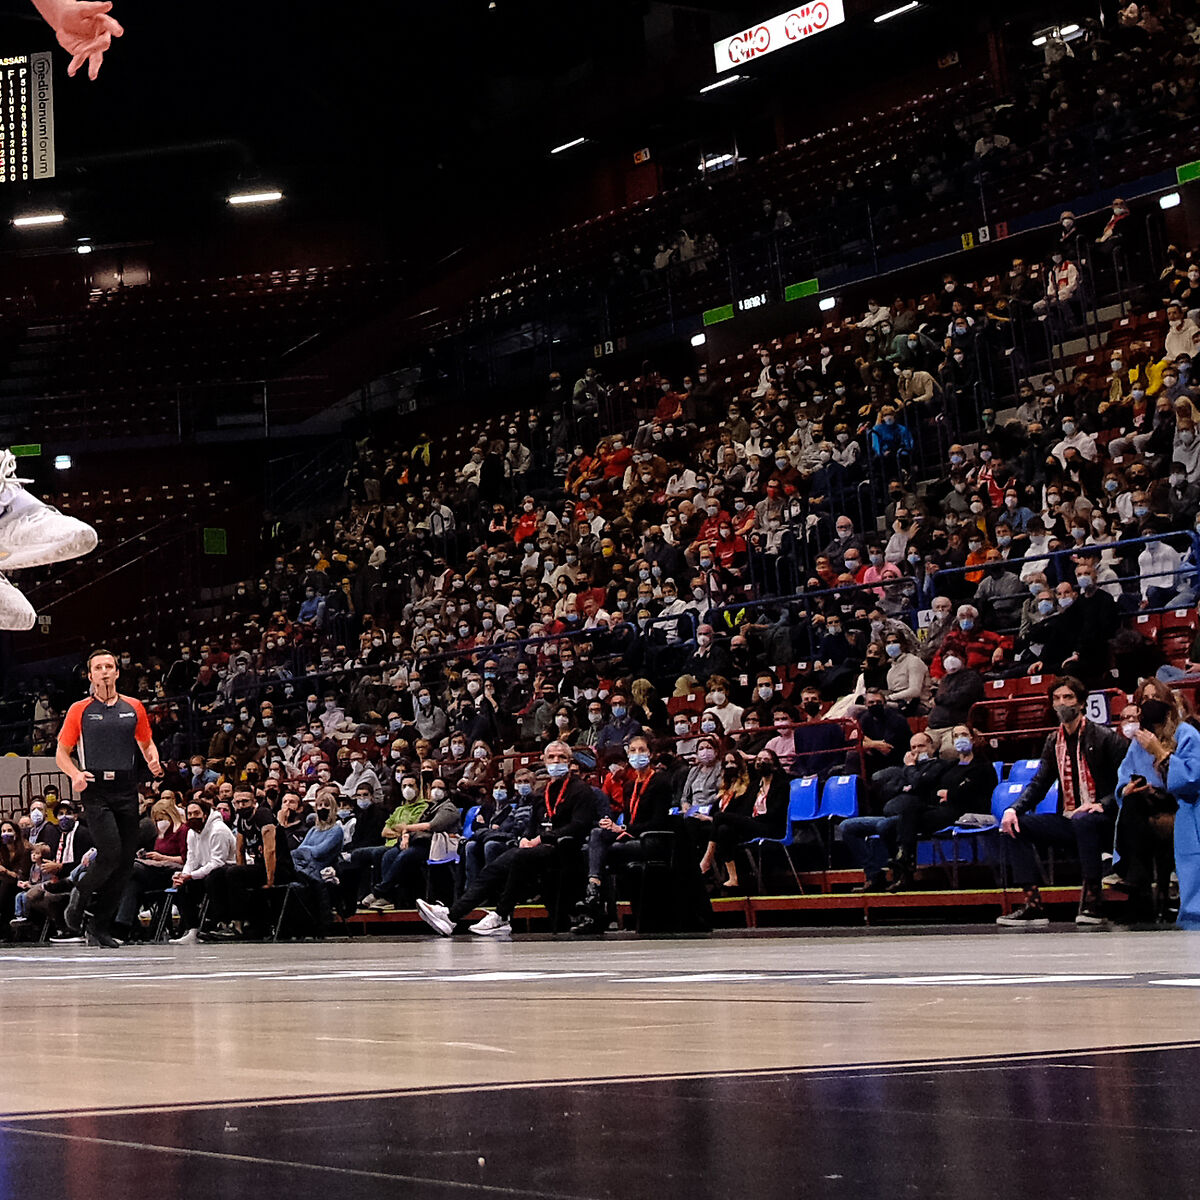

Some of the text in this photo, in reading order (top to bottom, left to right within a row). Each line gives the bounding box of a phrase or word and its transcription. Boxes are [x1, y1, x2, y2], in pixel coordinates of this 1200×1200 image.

[8, 70, 15, 81] F
[19, 68, 27, 79] P
[36, 59, 50, 174] mediolanumforum
[1091, 699, 1101, 718] 5
